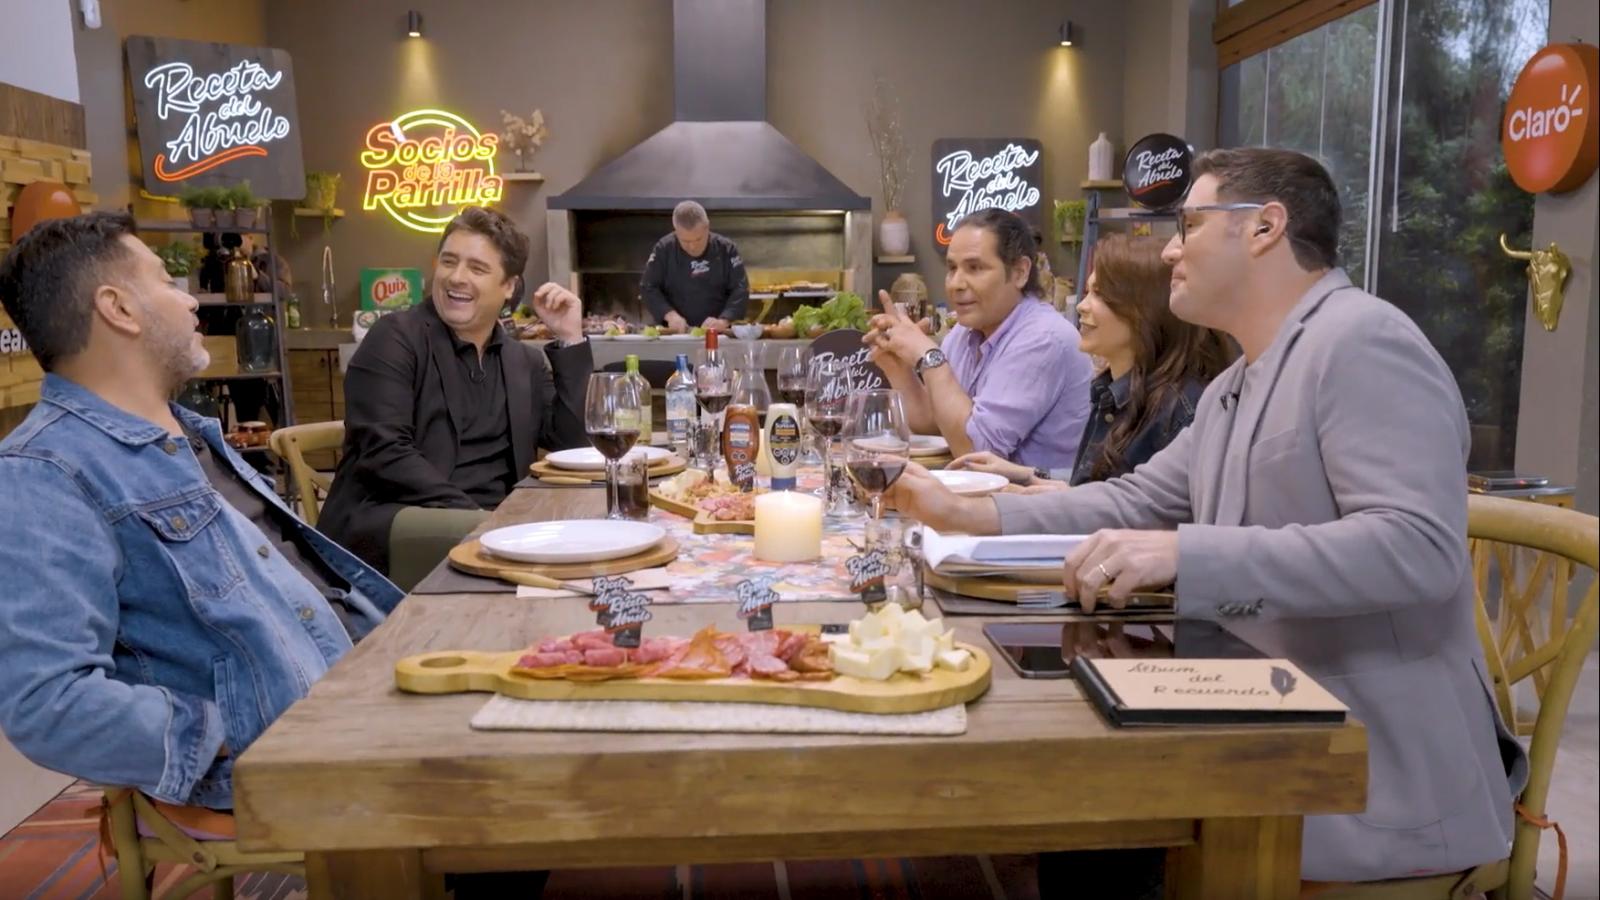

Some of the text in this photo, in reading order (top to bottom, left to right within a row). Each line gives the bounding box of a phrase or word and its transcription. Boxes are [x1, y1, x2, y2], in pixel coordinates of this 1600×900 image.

[145, 60, 283, 120] Receta
[219, 94, 261, 120] del
[167, 107, 290, 163] Abuelo
[1509, 106, 1570, 141] Claro
[361, 122, 499, 168] Socios
[403, 160, 455, 181] de la
[936, 143, 1039, 197] Receta
[1136, 147, 1184, 172] Receta
[363, 168, 503, 210] Parrilla
[986, 171, 1020, 194] del
[1138, 165, 1183, 188] Abuelo
[374, 278, 407, 303] Quix
[1188, 674, 1225, 683] del
